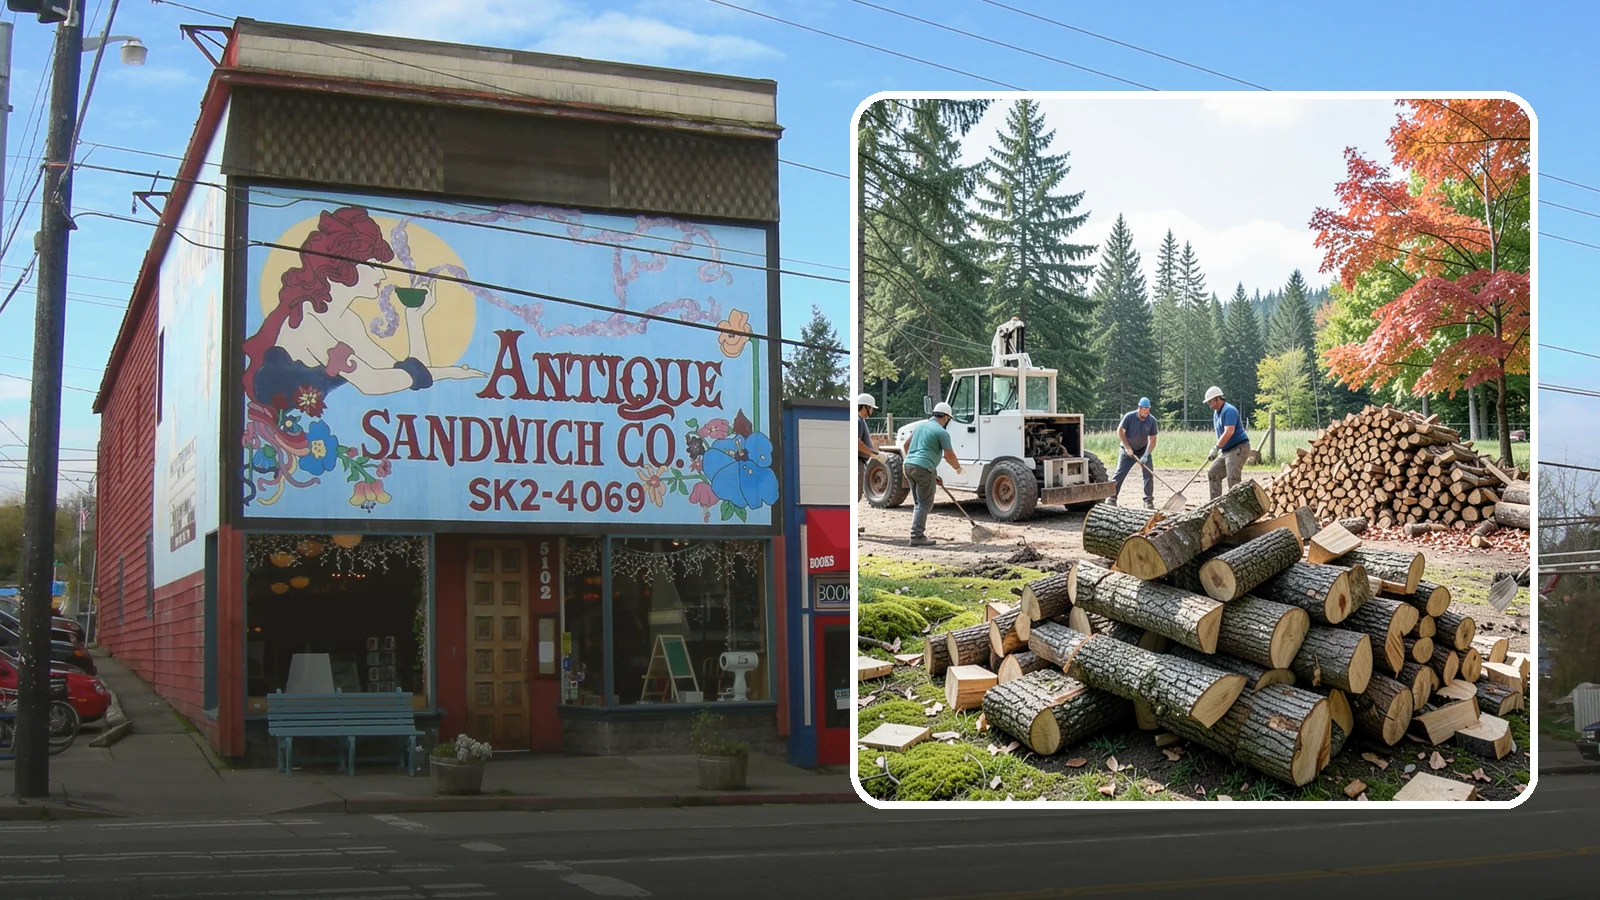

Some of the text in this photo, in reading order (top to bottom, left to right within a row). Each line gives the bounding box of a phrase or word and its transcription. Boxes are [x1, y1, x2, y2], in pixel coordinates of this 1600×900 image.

[476, 329, 724, 421] ANTIQUE
[361, 408, 685, 468] SANDWICH CO.
[468, 477, 646, 513] SK2-4069
[540, 541, 551, 599] 5102
[809, 555, 834, 569] BOOKS
